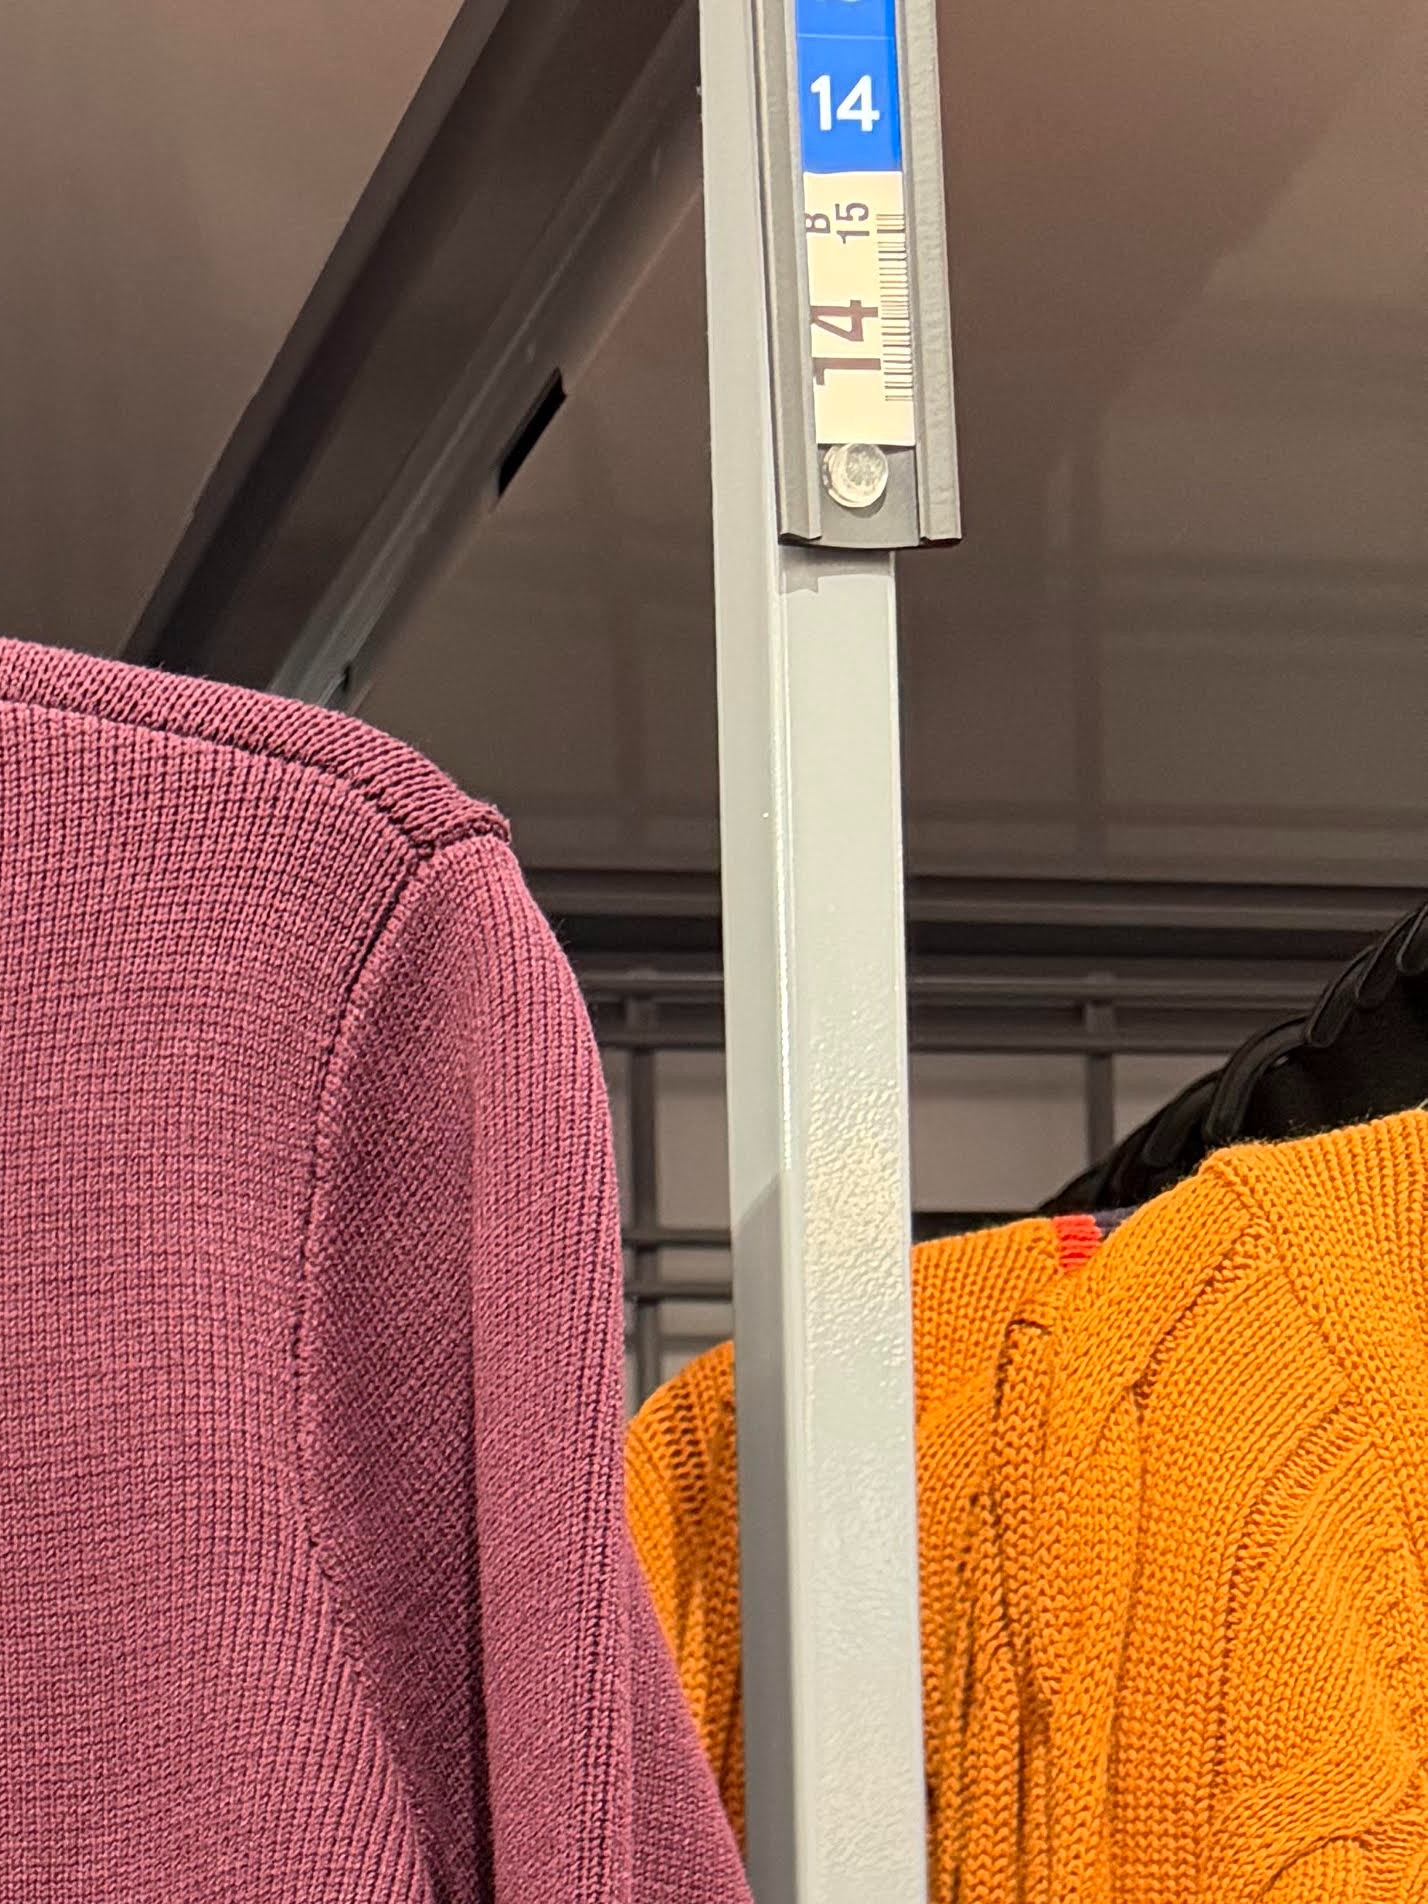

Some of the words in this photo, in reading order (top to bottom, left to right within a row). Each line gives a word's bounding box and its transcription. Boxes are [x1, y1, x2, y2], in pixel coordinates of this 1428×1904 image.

[810, 74, 881, 132] 14
[834, 202, 870, 245] 15
[810, 299, 882, 386] 14
